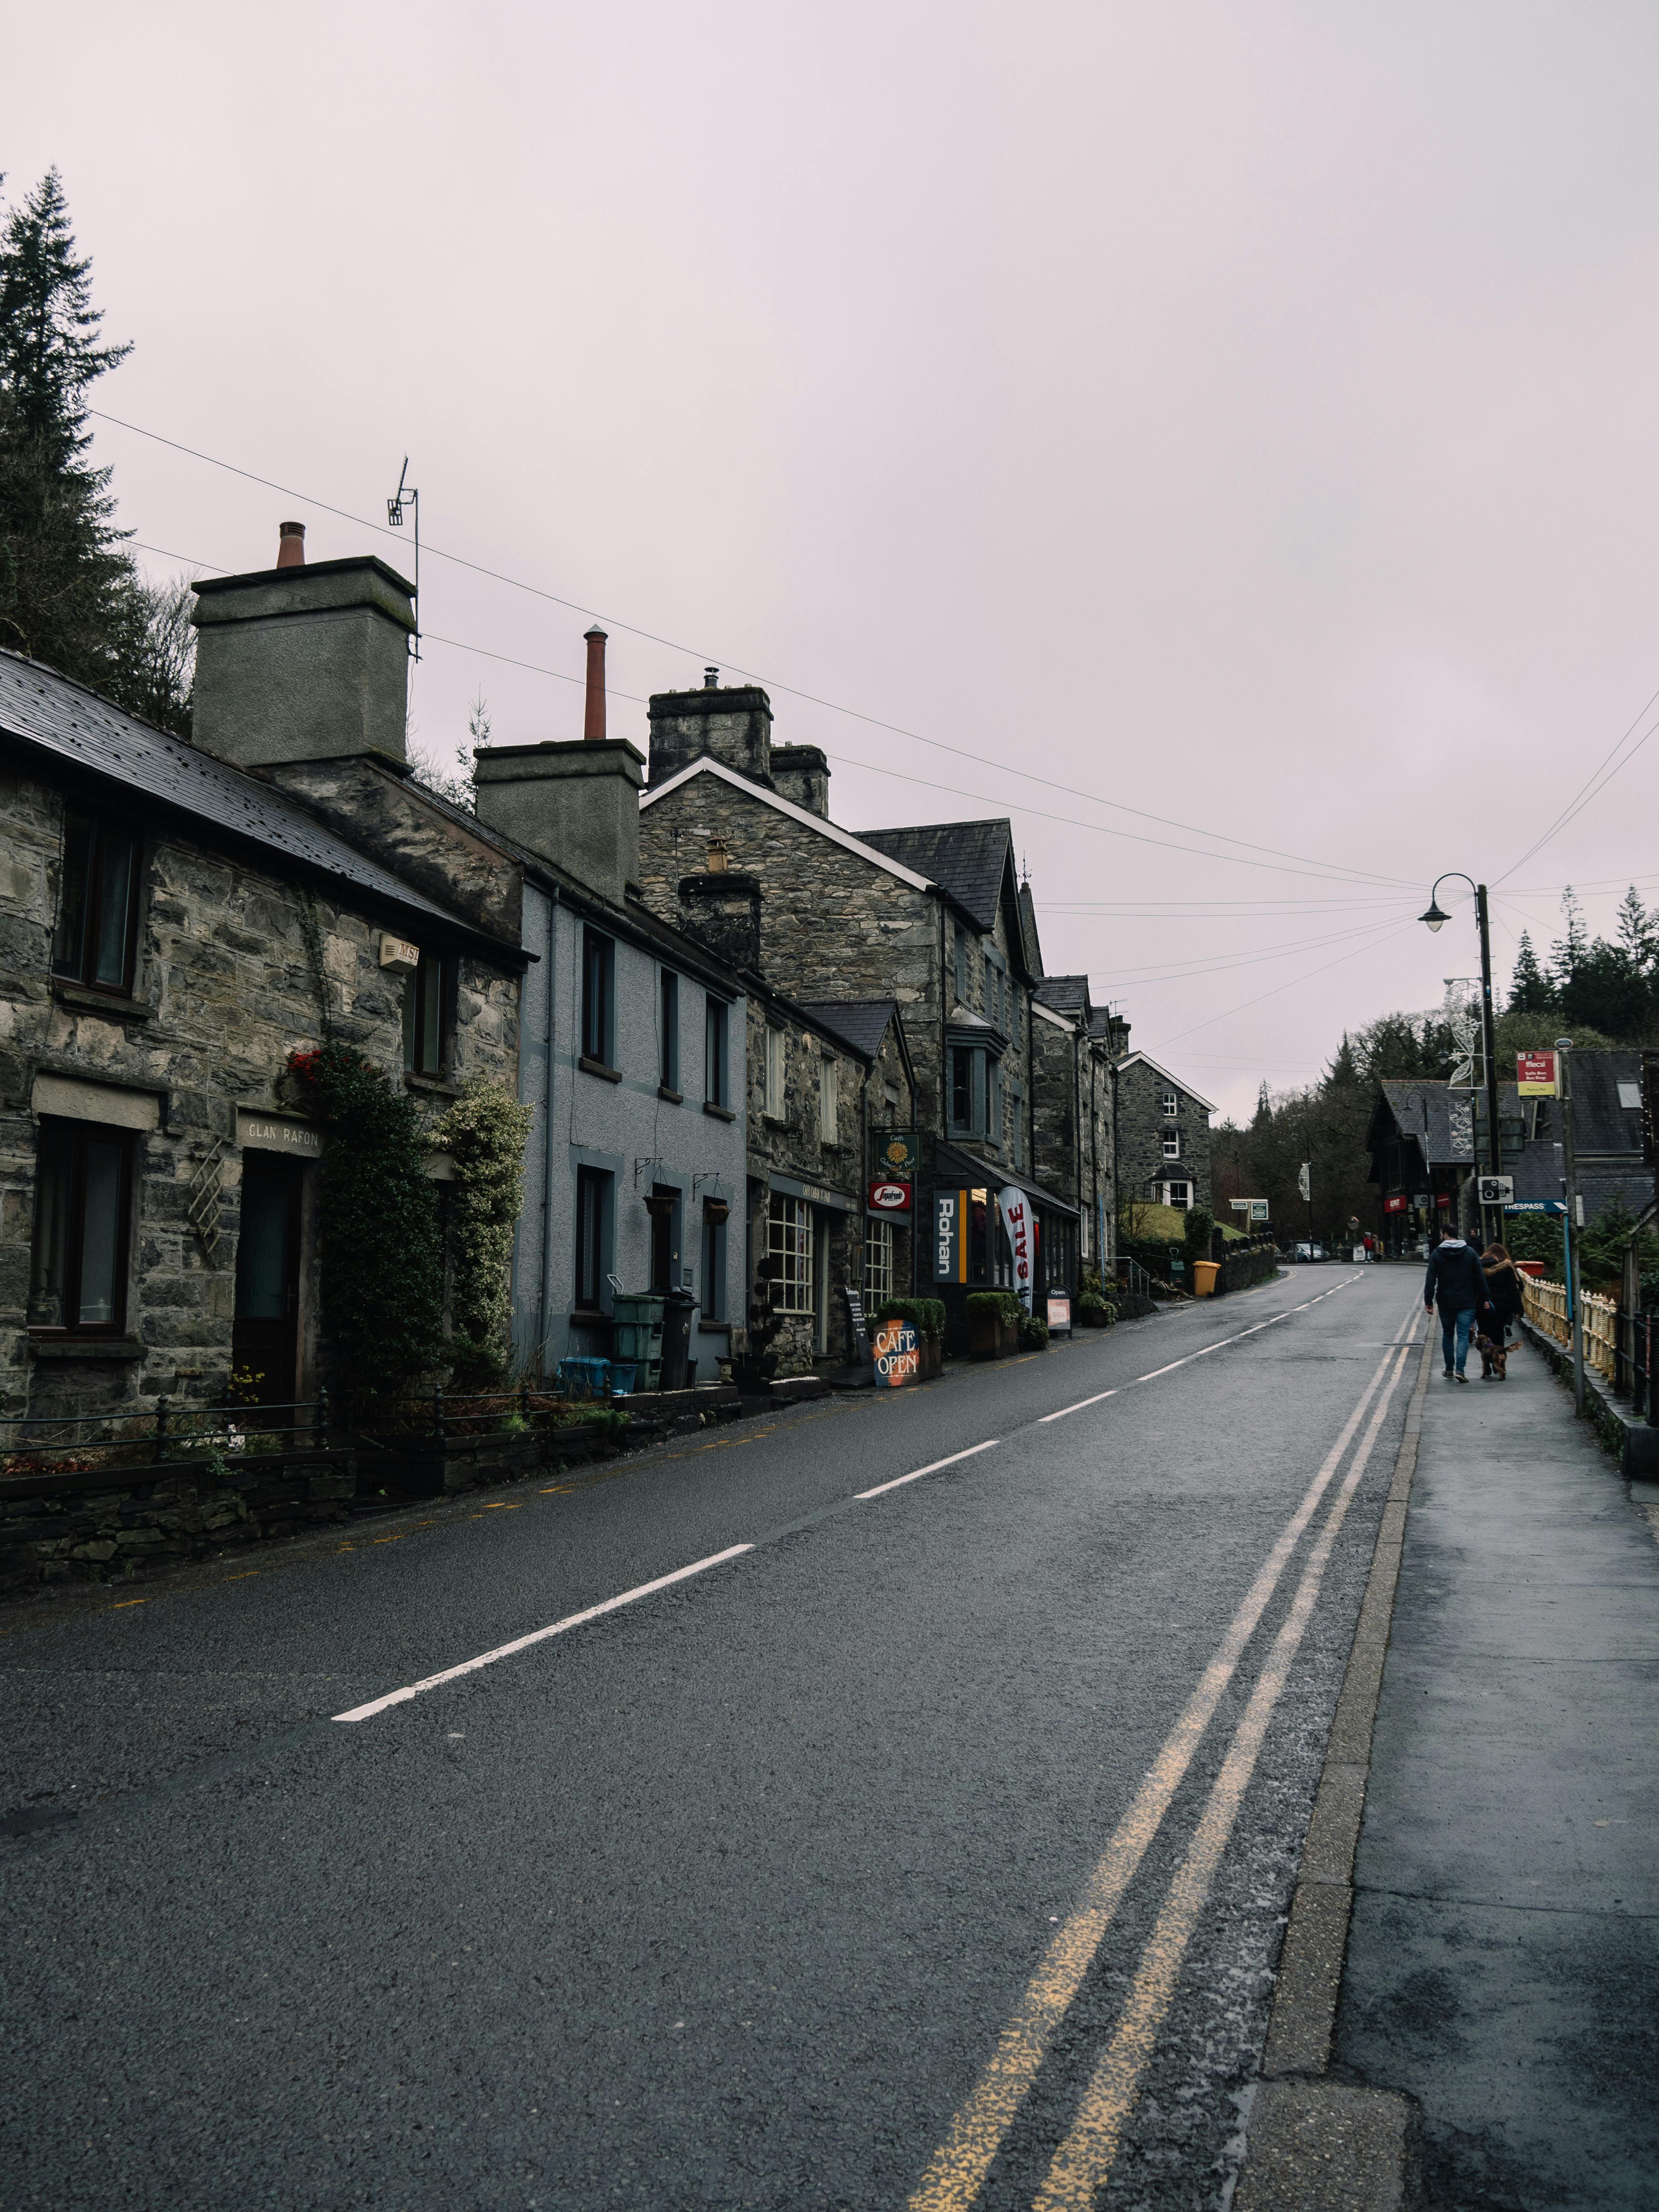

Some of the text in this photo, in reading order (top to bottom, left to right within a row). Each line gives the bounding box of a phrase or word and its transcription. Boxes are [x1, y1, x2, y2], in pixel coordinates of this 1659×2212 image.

[399, 943, 419, 960] MSI
[249, 1123, 318, 1147] GLAN RAFON
[939, 1199, 954, 1274] Rohan
[1007, 1203, 1028, 1280] SALE
[876, 1330, 915, 1353] CAFE
[878, 1355, 917, 1374] OPEN
